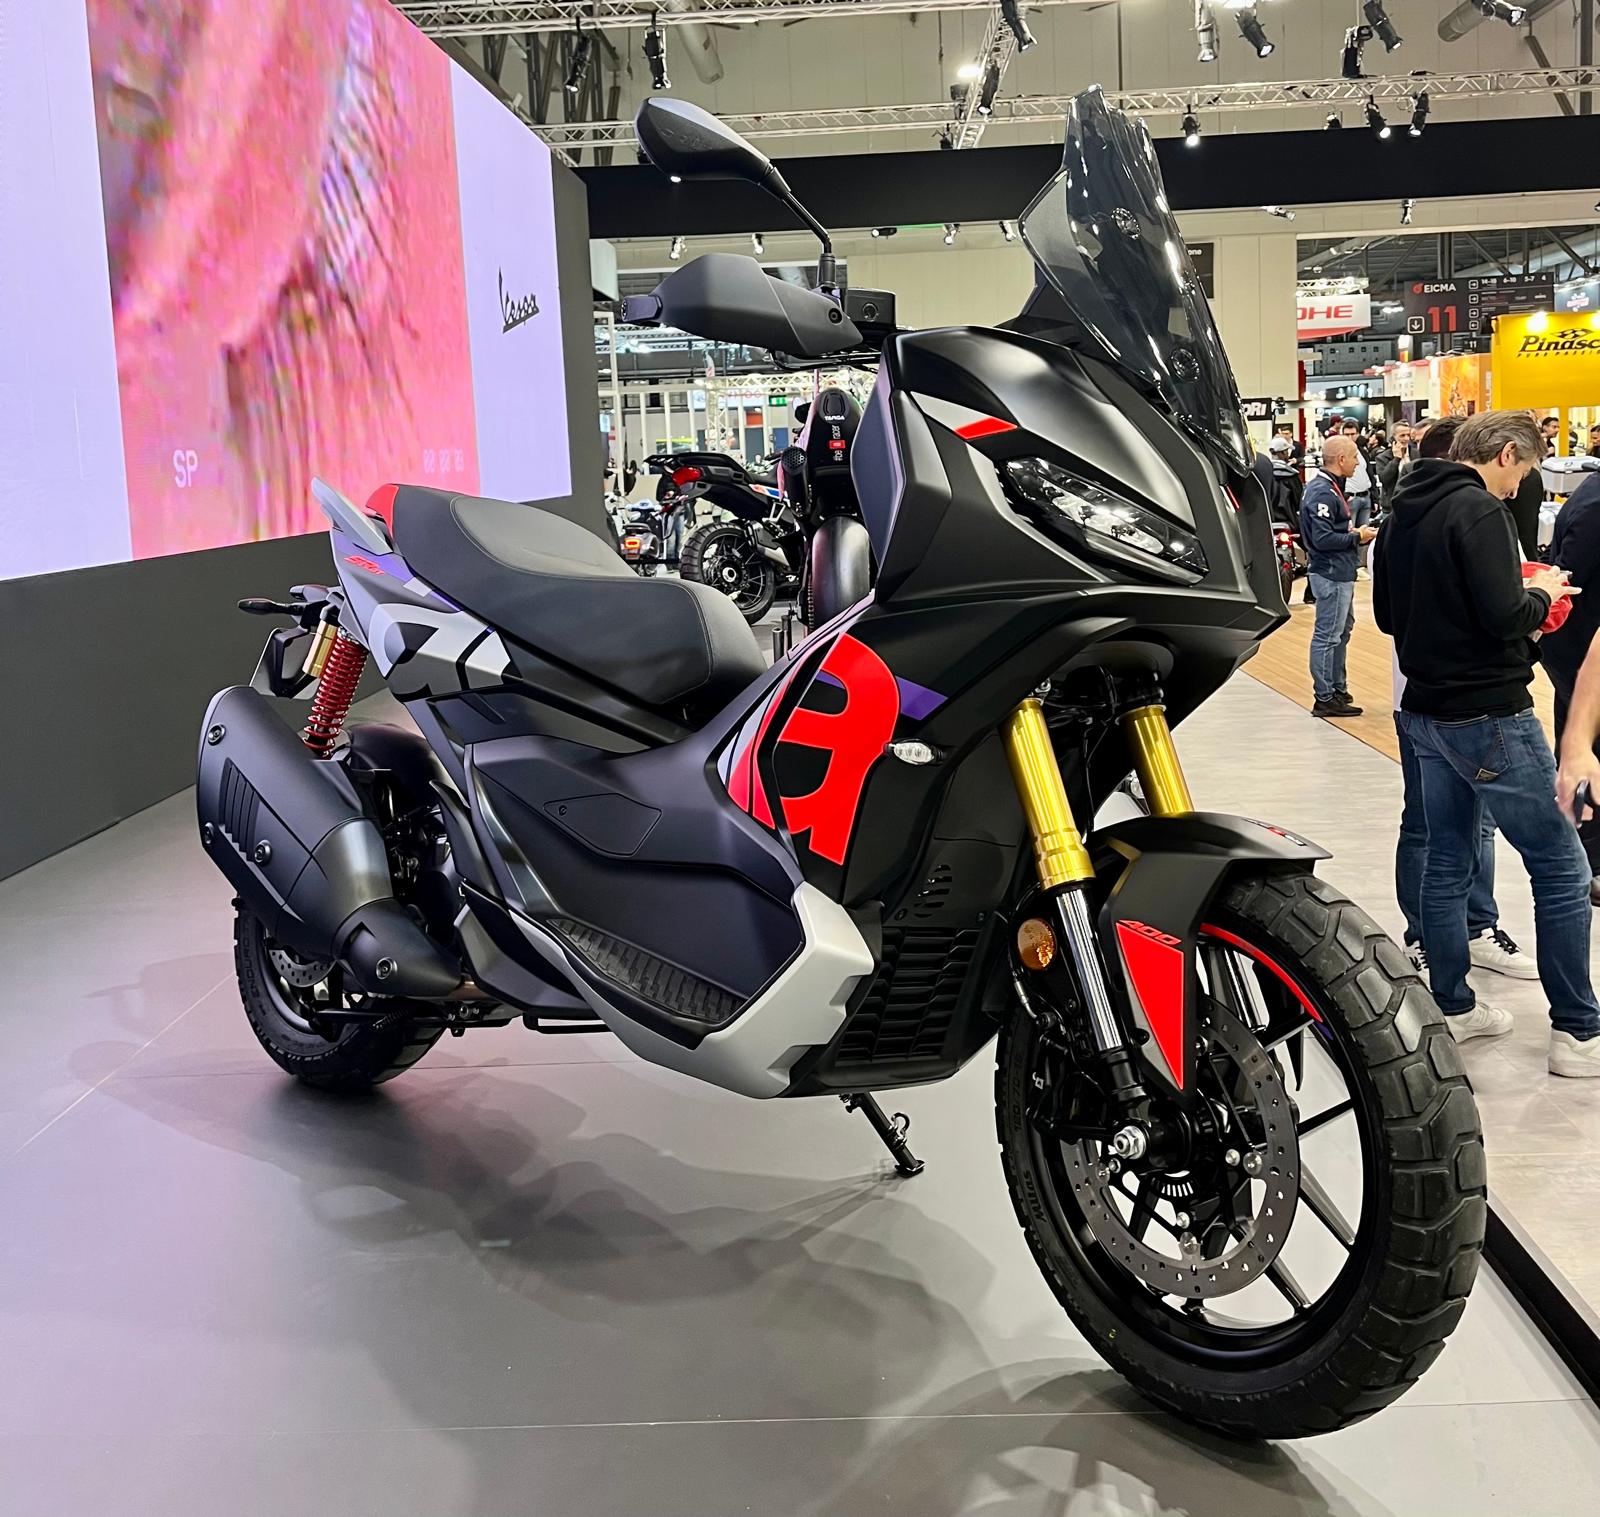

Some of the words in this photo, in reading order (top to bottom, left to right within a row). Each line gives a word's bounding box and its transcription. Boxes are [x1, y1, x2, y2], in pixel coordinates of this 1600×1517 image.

[498, 267, 540, 335] Vespa
[1423, 283, 1457, 294] EICMA
[1427, 305, 1457, 333] 11
[173, 449, 198, 488] SP
[1119, 919, 1182, 945] 400
